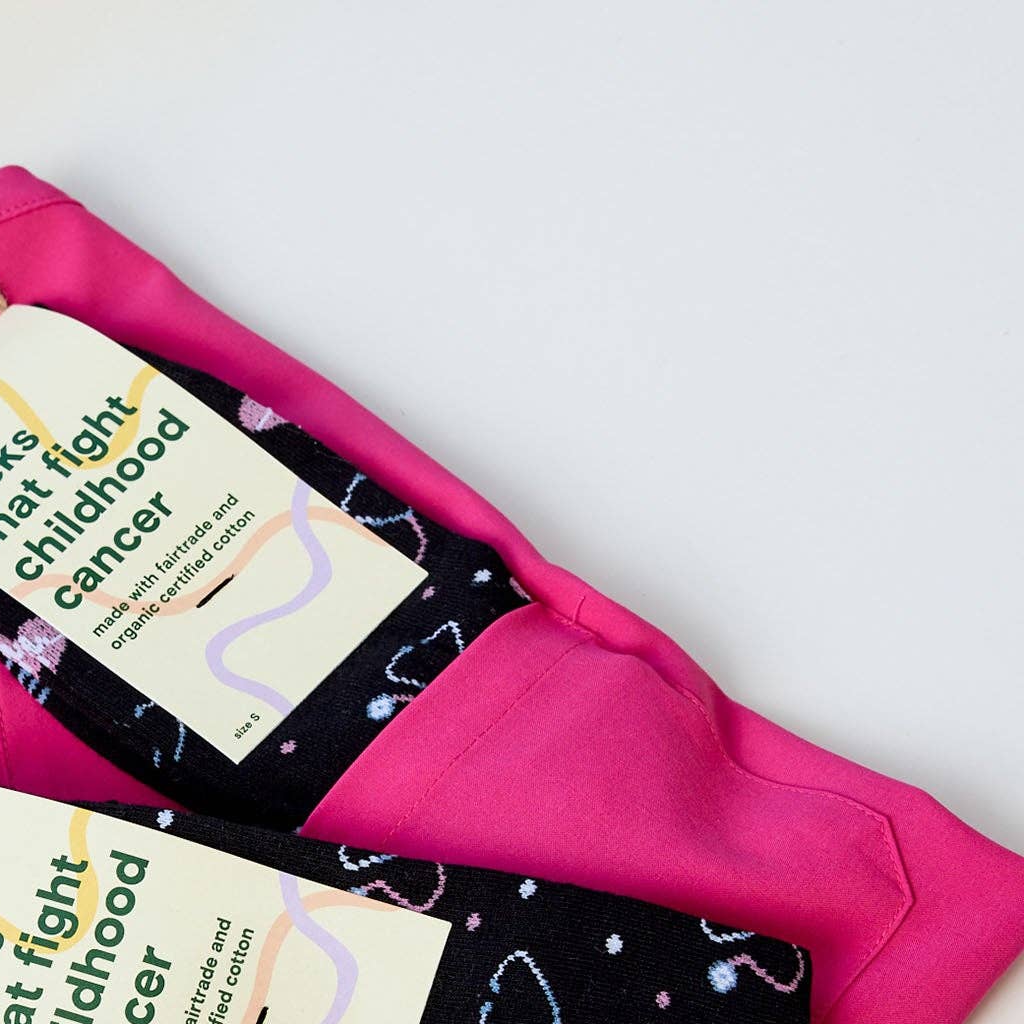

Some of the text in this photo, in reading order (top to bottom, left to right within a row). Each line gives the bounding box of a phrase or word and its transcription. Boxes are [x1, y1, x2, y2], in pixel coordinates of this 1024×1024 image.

[42, 396, 138, 478] fight
[15, 408, 191, 581] childhood
[53, 491, 173, 610] cancer
[92, 493, 239, 637] made with fairtrade and
[111, 510, 255, 650] organic certified cotton
[234, 713, 260, 739] size S
[14, 854, 89, 967] fight
[212, 917, 232, 953] and
[226, 928, 255, 987] cotton
